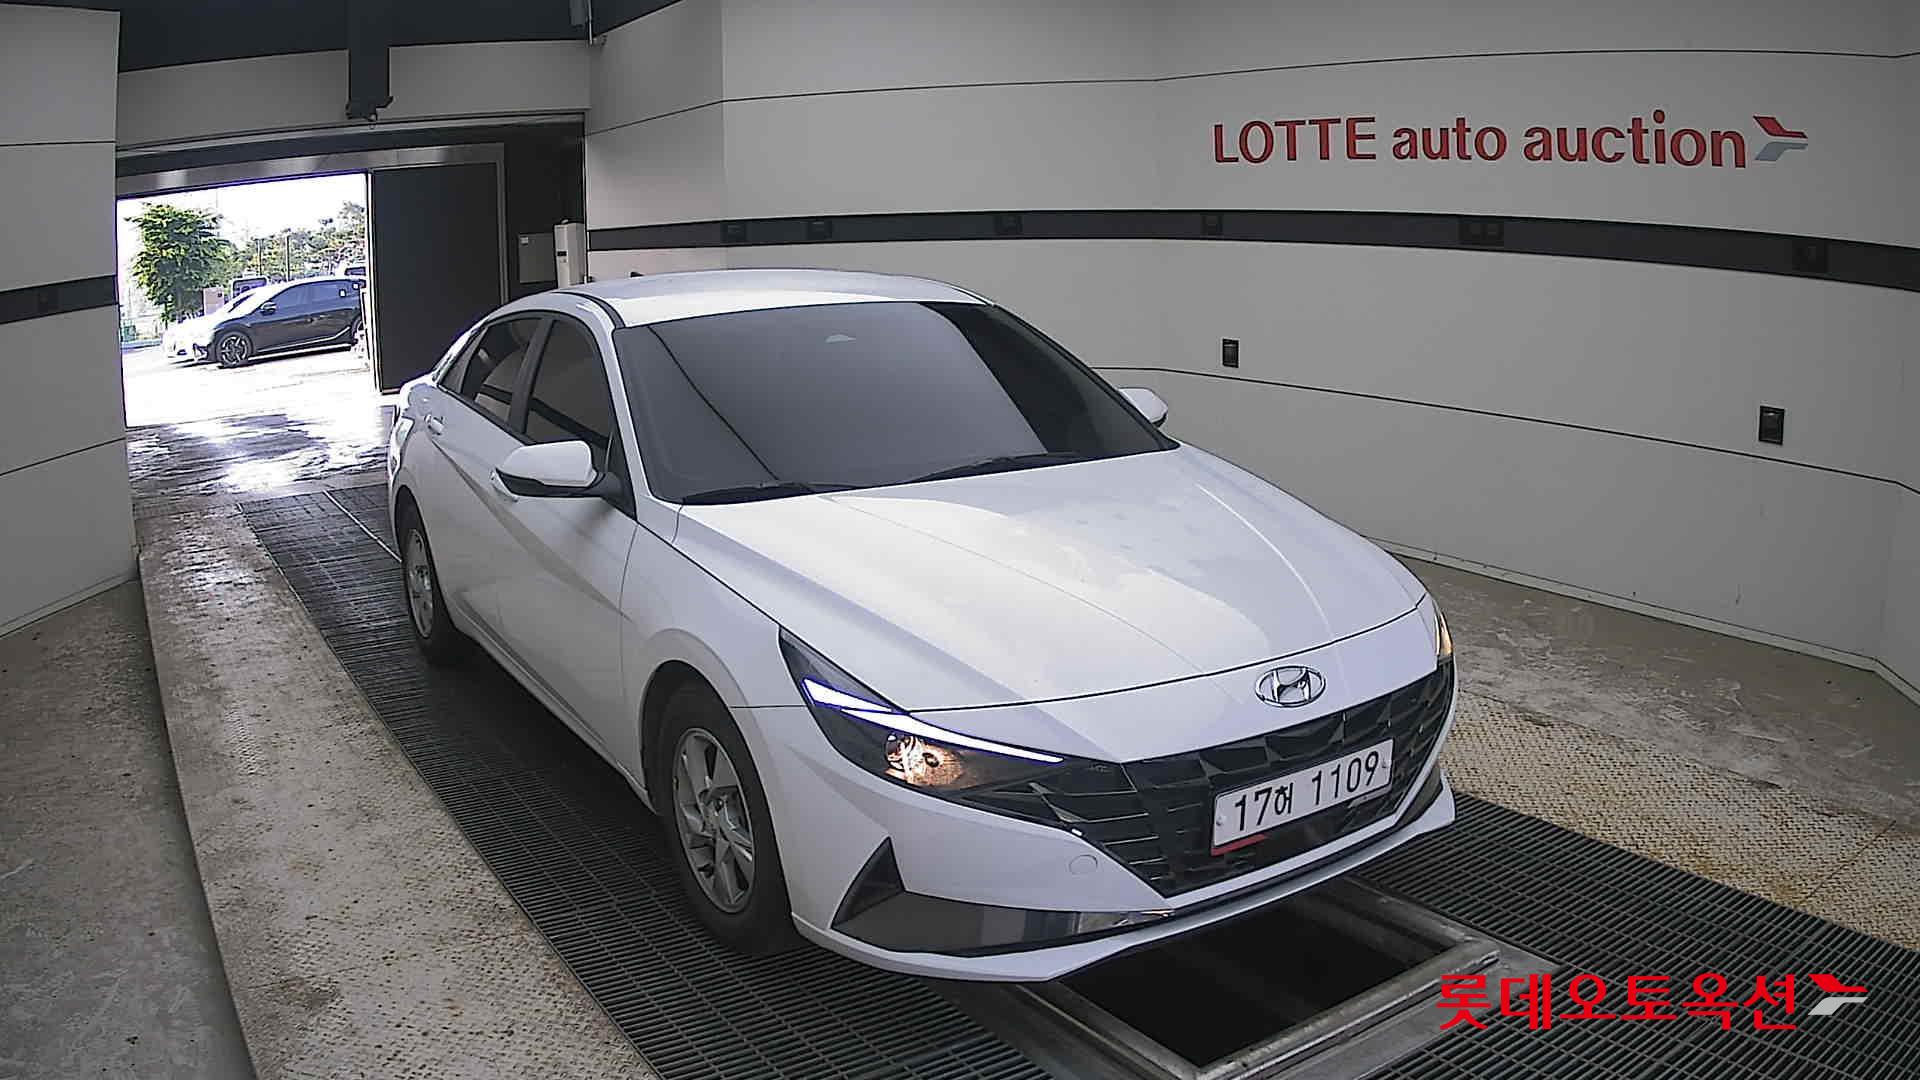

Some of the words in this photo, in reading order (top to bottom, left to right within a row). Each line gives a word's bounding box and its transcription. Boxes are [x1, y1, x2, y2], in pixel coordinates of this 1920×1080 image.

[1213, 116, 1377, 164] LOTTE
[1392, 117, 1507, 161] auto
[1523, 109, 1746, 168] auction
[1234, 782, 1294, 831] 17허
[1311, 750, 1379, 805] 1109
